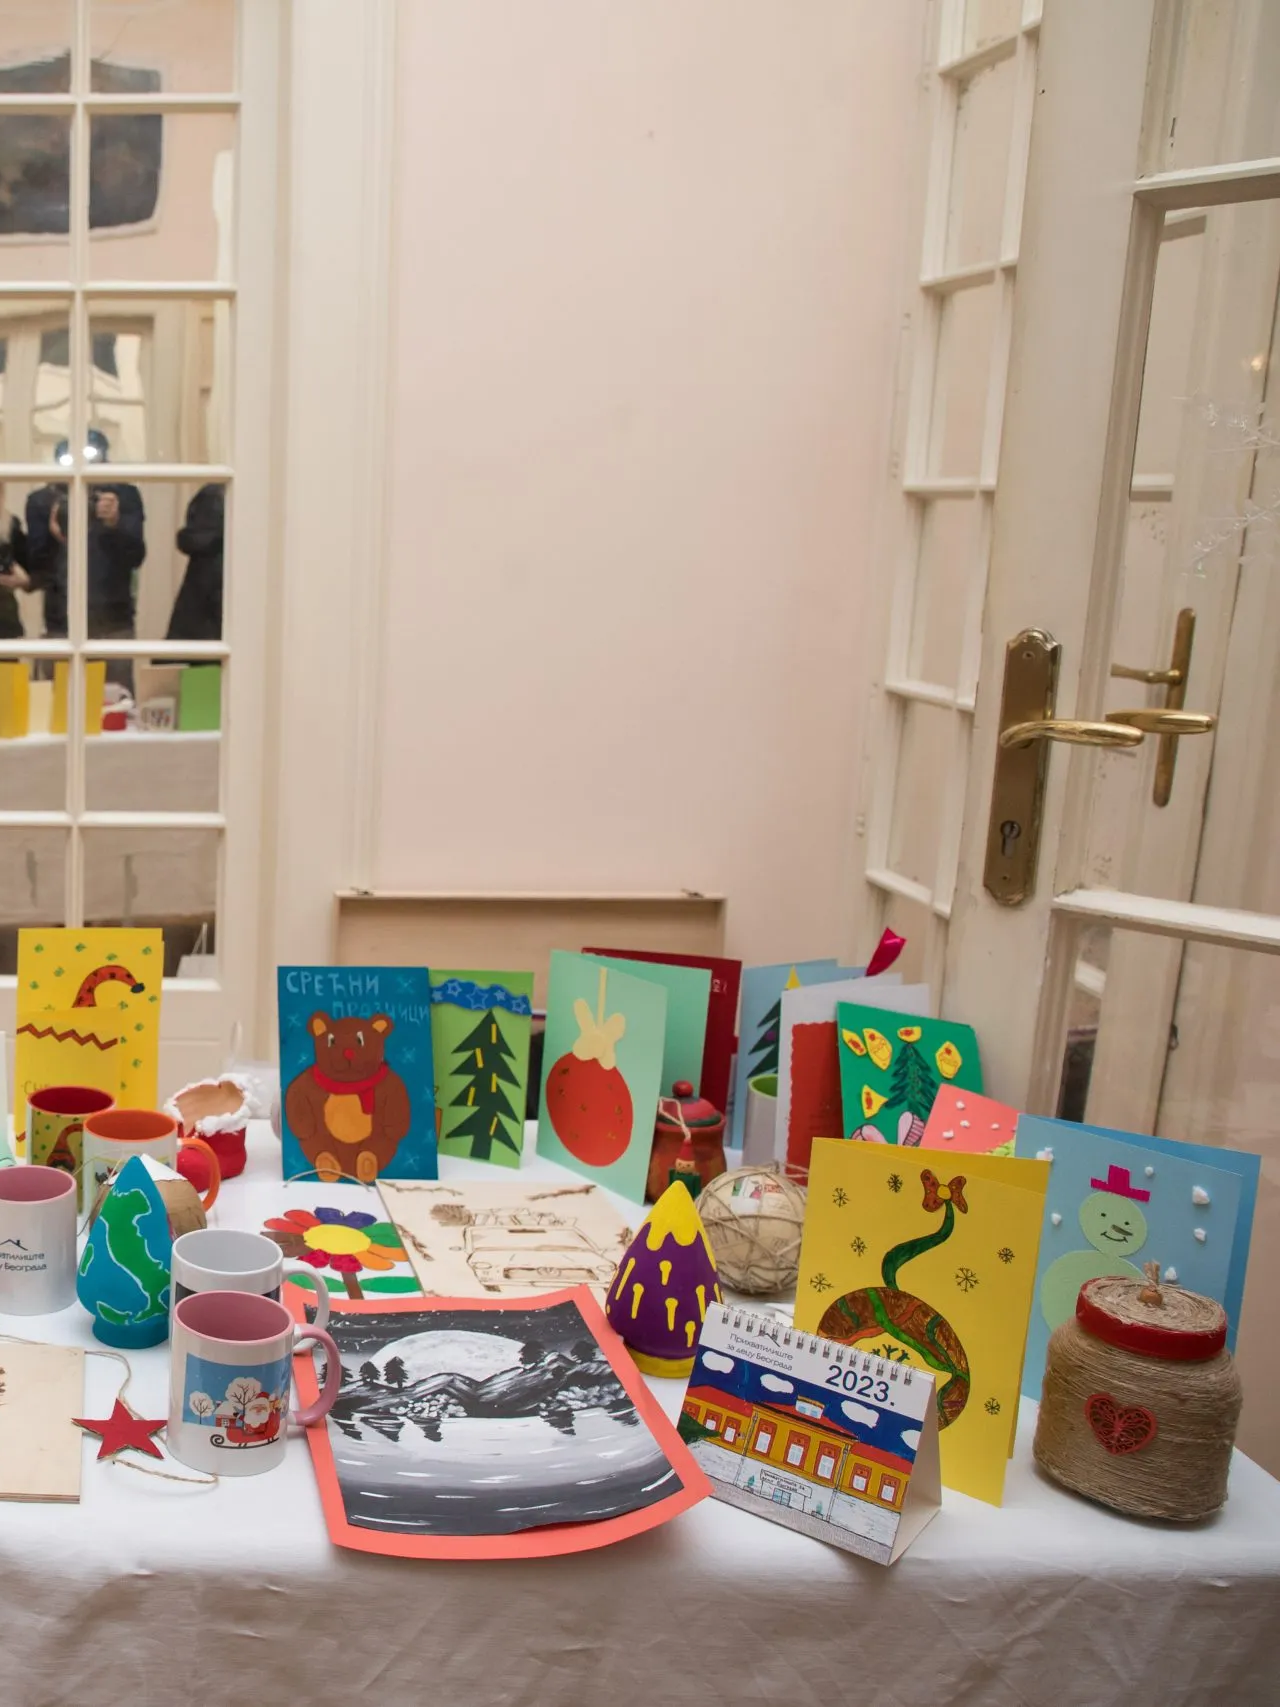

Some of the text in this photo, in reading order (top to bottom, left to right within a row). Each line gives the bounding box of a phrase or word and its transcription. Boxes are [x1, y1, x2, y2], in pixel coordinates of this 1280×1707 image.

[285, 971, 379, 997] СРЕЋНИ
[725, 1343, 793, 1371] за децу Београда
[729, 1332, 794, 1361] Прихватилиште
[825, 1365, 895, 1406] 2023.
